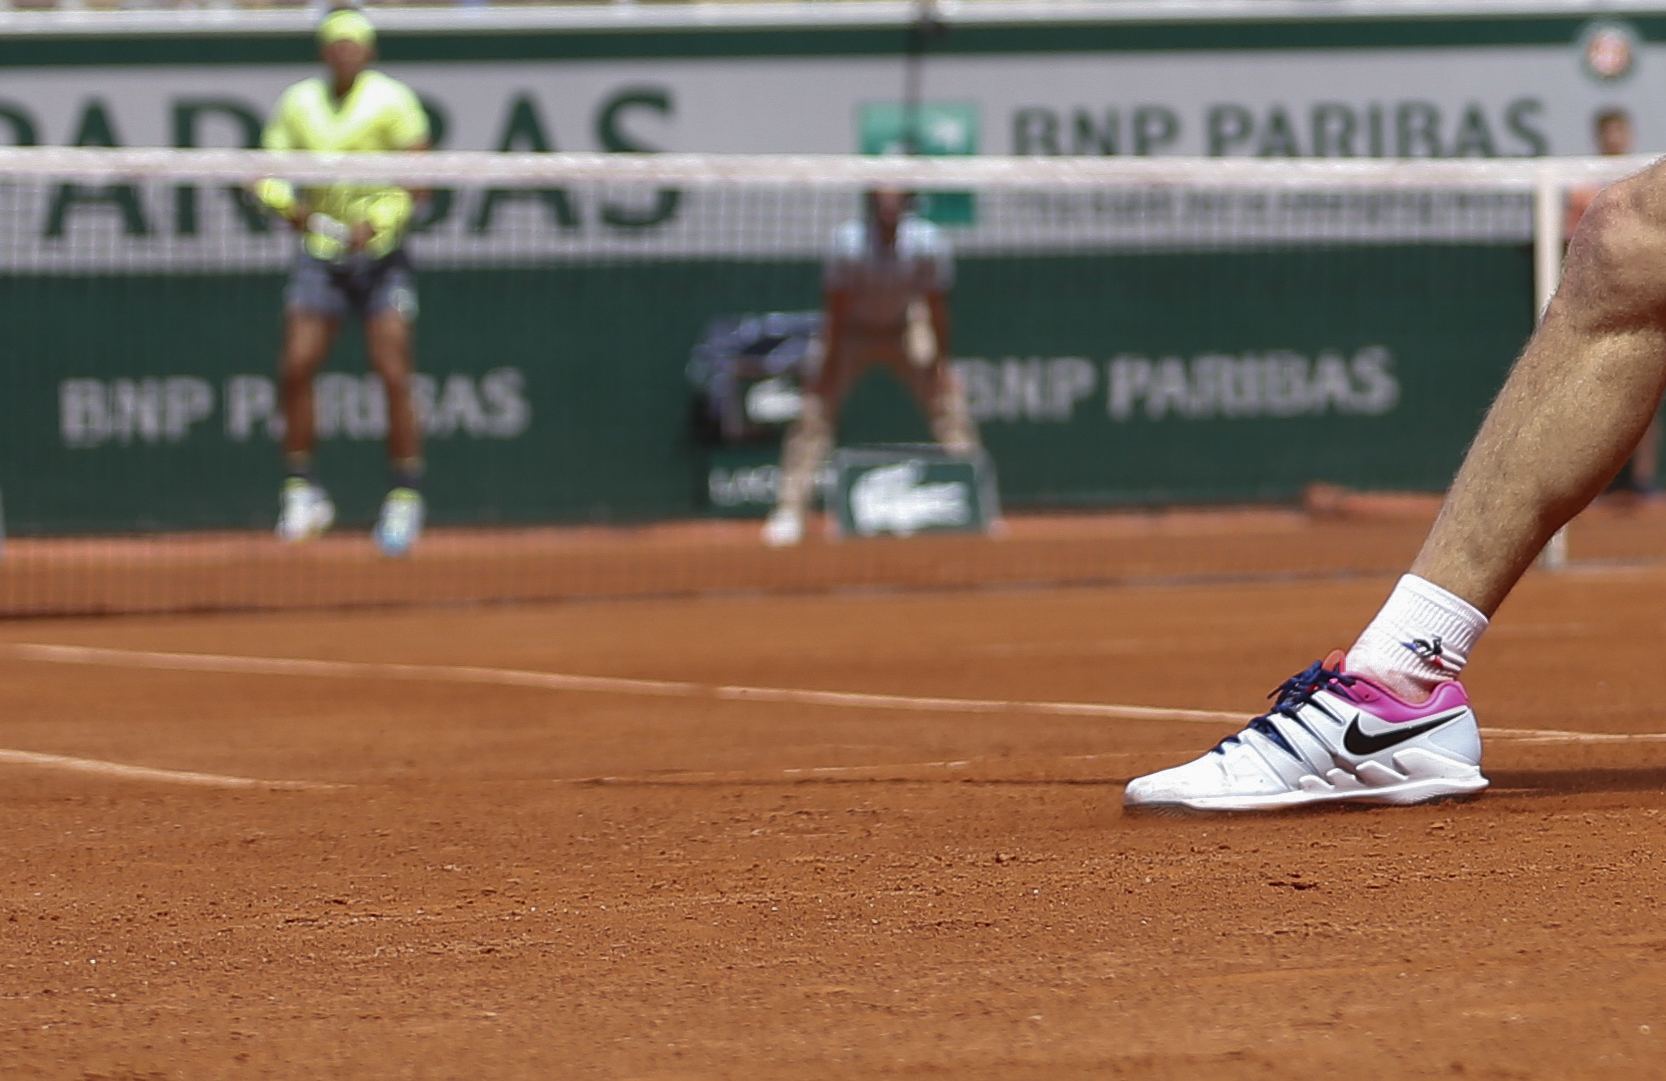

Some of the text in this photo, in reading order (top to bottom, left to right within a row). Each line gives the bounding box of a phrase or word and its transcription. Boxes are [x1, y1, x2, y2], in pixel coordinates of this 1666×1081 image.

[1011, 96, 1551, 158] BNP PARIBAS
[58, 375, 216, 448] BNP
[953, 345, 1402, 421] BNP PARIBAS
